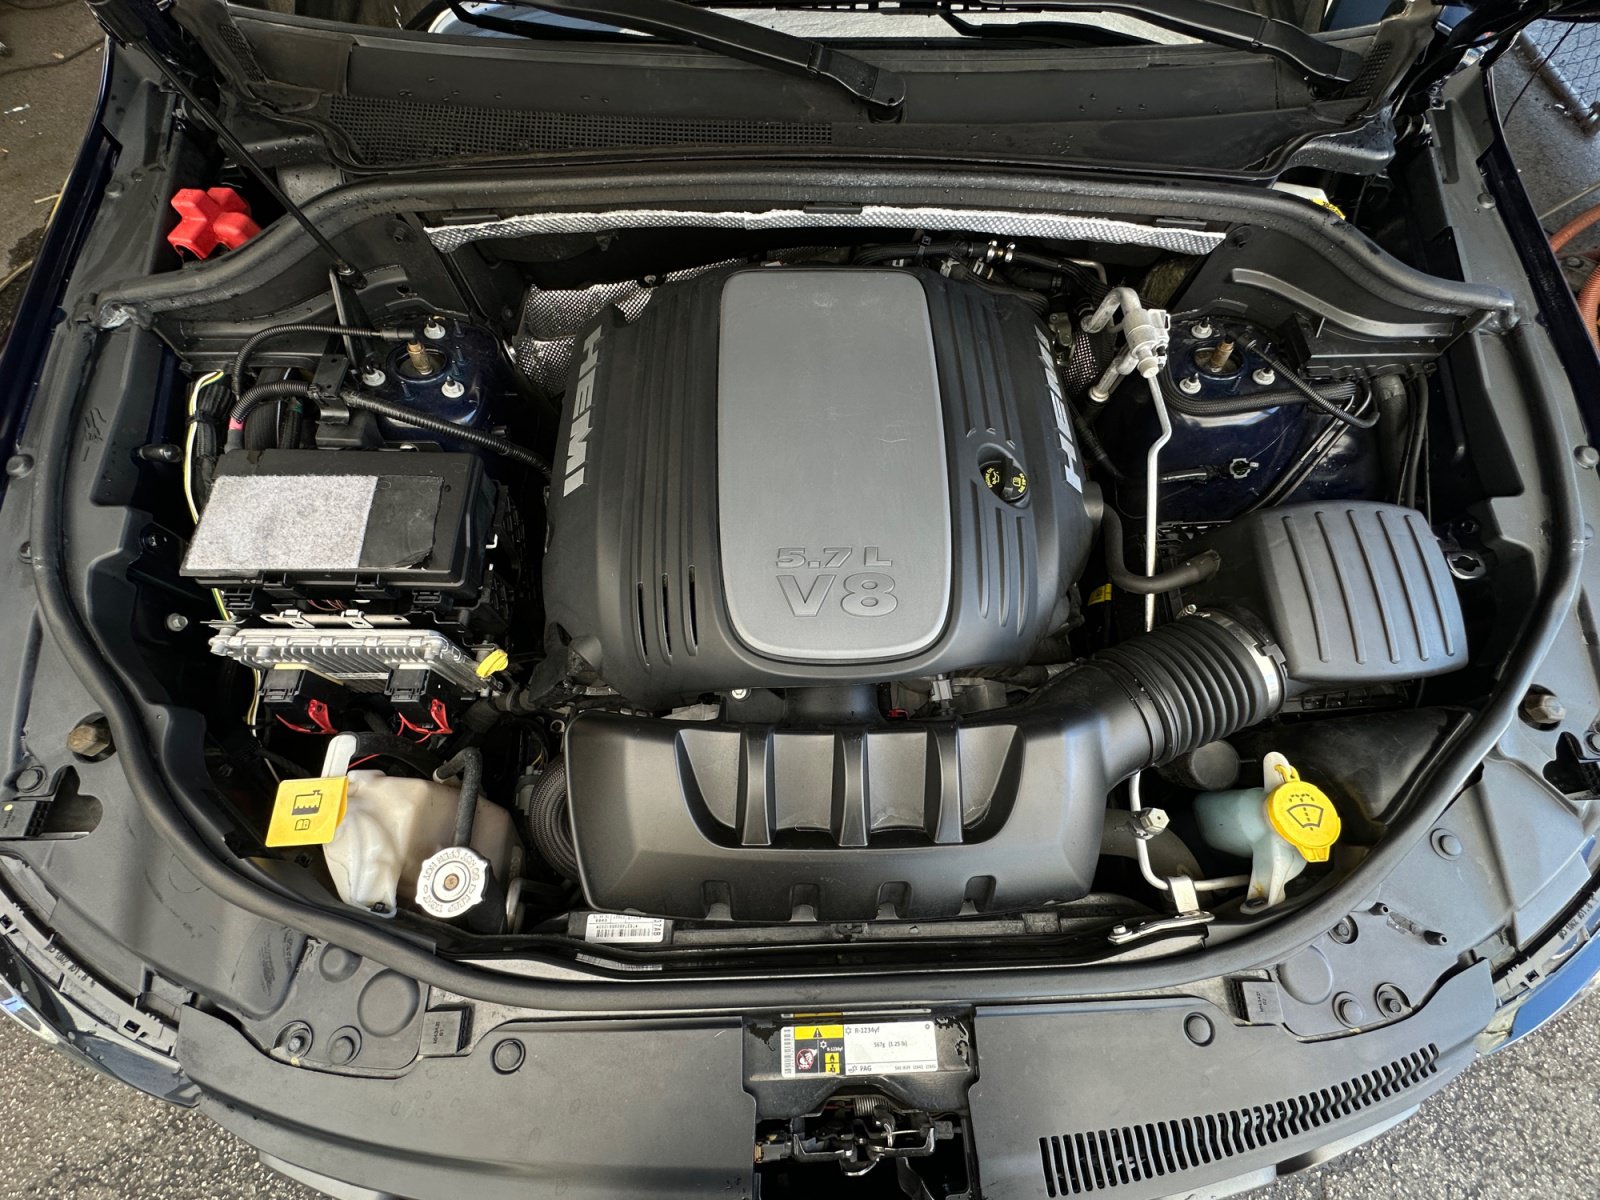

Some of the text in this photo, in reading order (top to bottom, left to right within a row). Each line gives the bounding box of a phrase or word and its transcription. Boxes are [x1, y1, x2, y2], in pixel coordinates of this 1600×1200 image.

[562, 325, 602, 498] HEMI
[1034, 324, 1083, 494] HEMI
[776, 571, 899, 618] V8
[854, 1026, 880, 1035] R-1234yf
